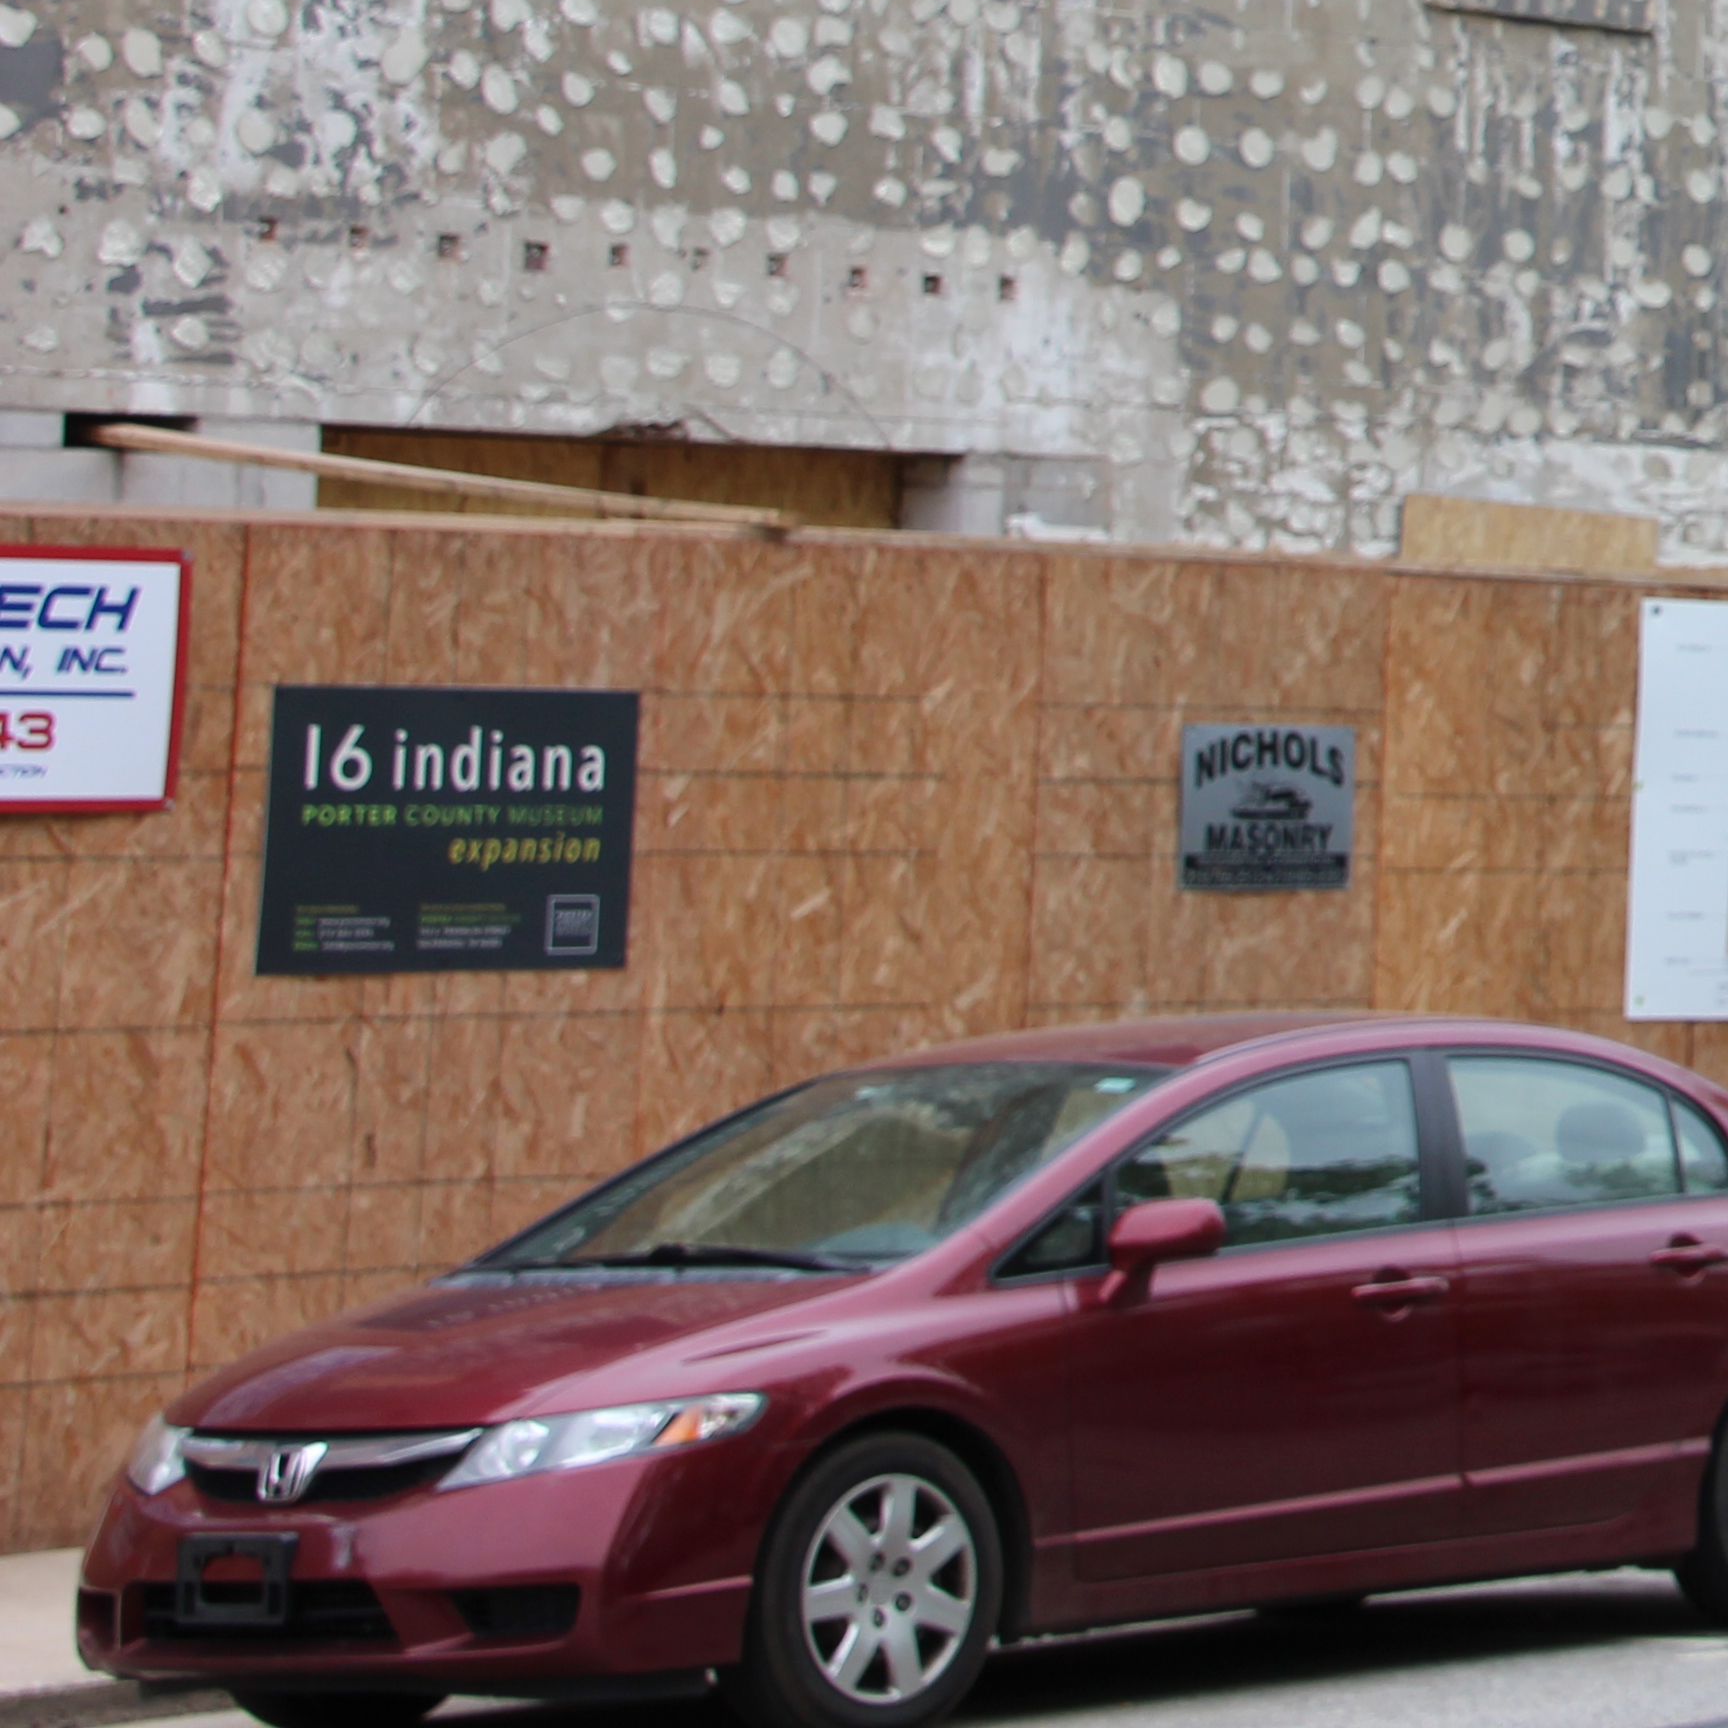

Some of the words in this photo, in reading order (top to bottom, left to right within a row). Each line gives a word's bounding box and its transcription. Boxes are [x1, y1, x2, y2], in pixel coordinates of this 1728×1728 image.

[57, 646, 127, 674] INC.
[304, 724, 373, 792] 16
[391, 725, 606, 792] indiana
[1195, 729, 1345, 790] NICHOLS
[302, 804, 397, 826] PORTER
[403, 804, 501, 826] COUNTY
[506, 804, 602, 827] MUSEUM
[449, 830, 601, 871] expansion
[1205, 823, 1332, 852] MASONRY
